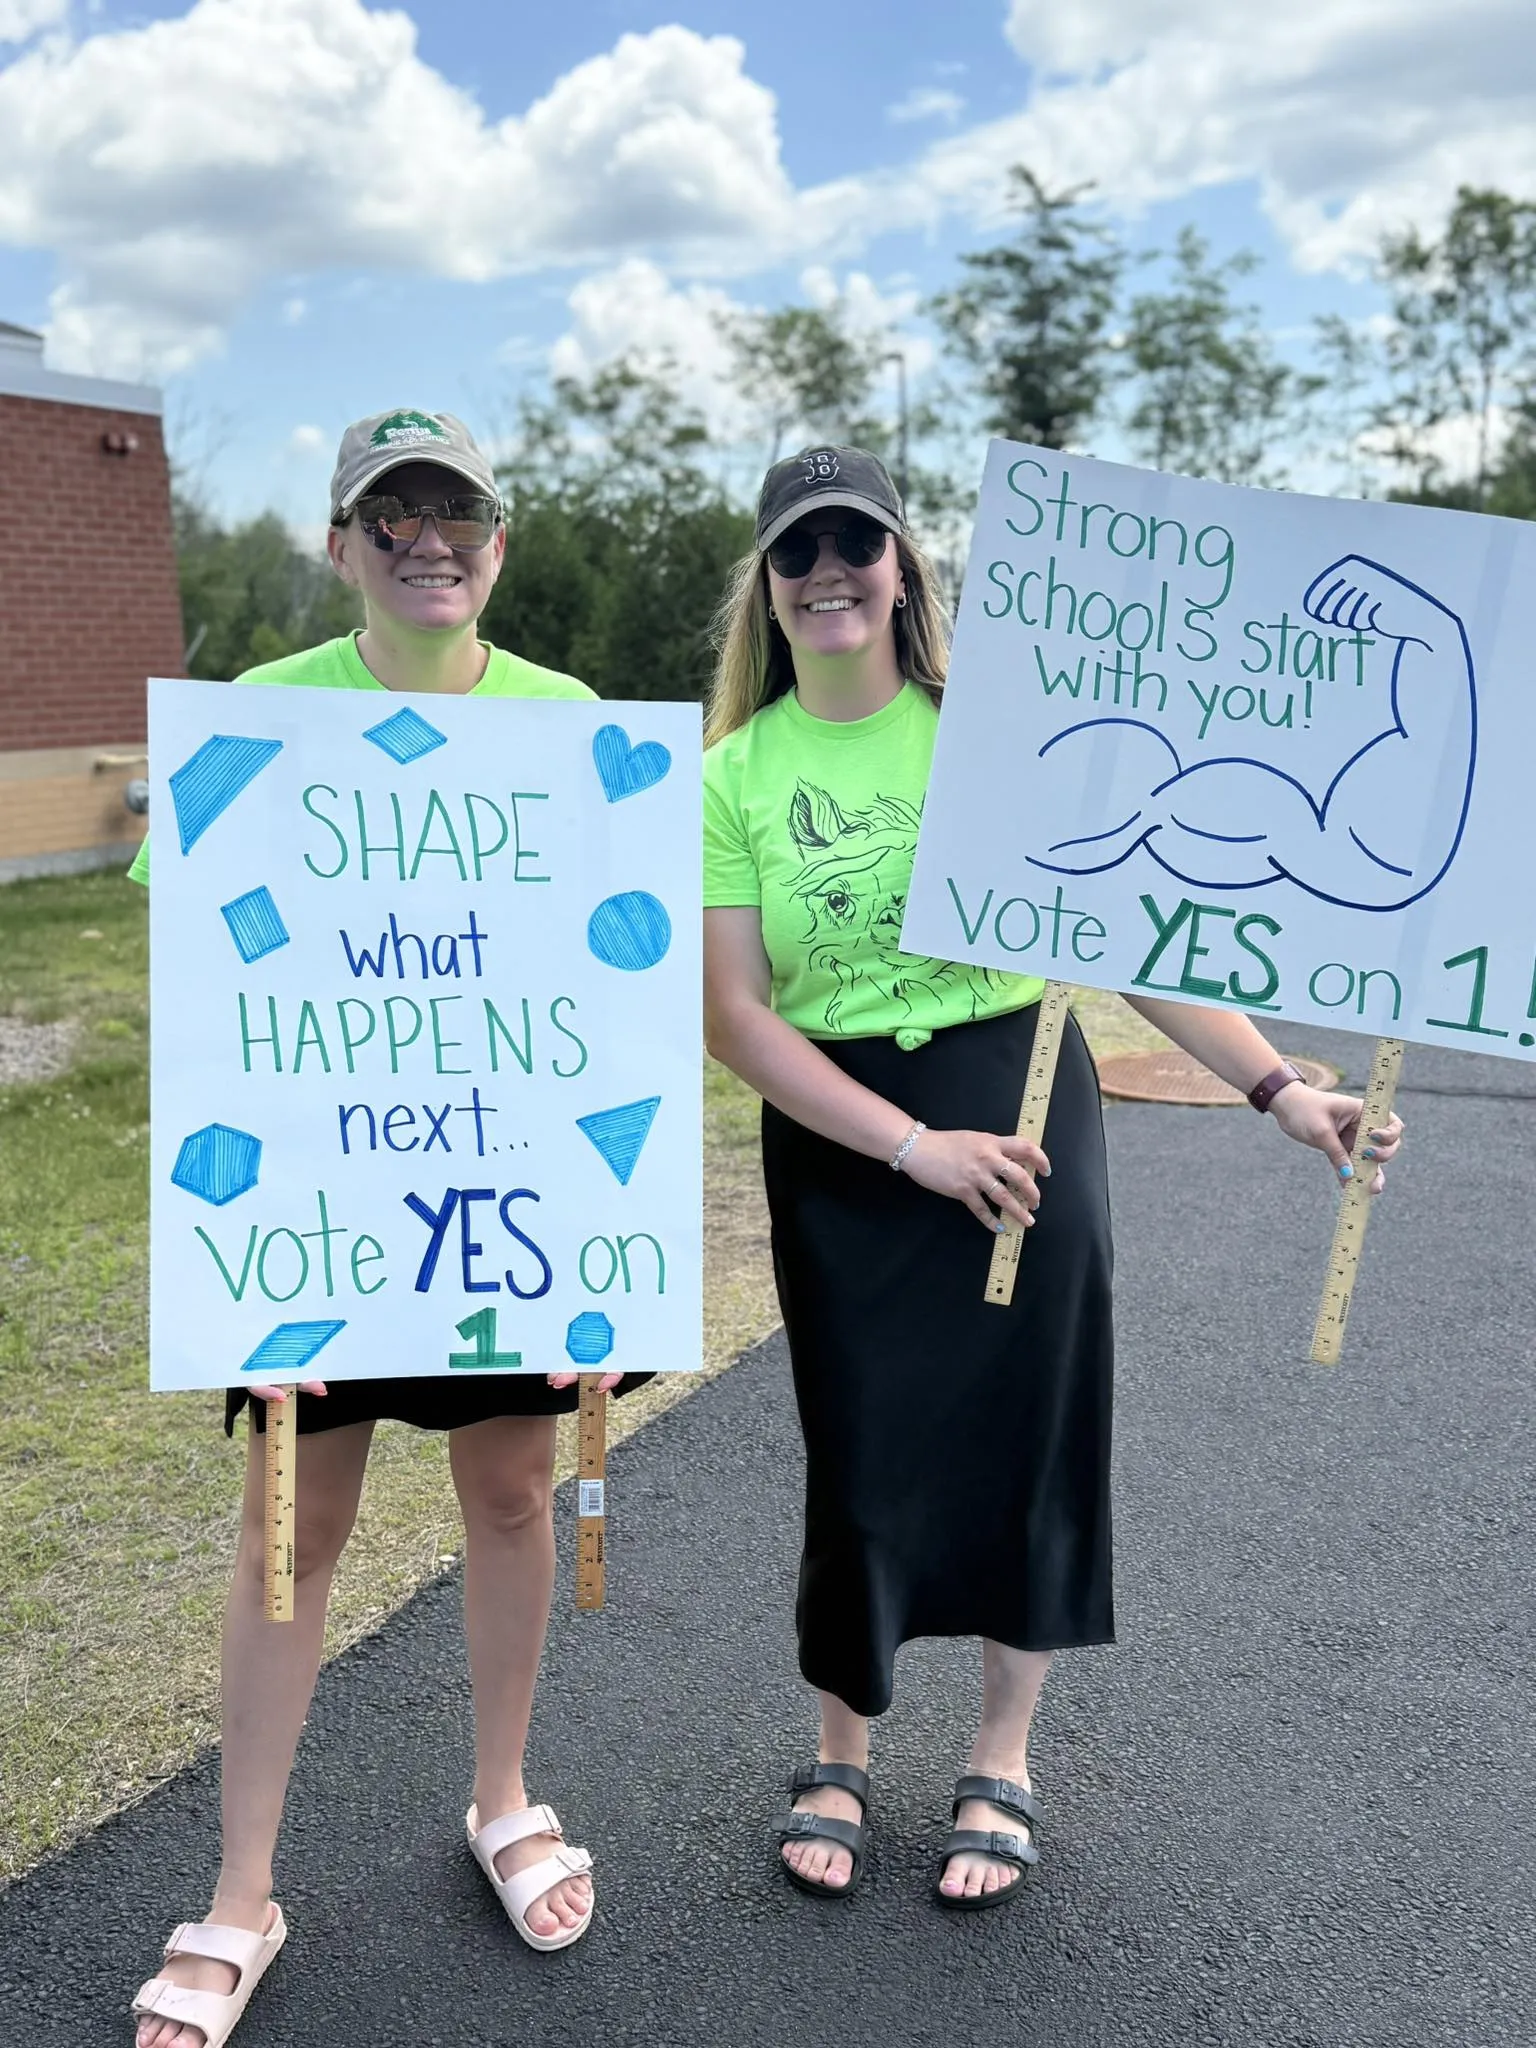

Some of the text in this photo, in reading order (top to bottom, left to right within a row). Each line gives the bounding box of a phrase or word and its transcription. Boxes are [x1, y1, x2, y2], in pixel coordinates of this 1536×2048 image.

[803, 452, 840, 484] B
[1005, 459, 1235, 609] Strong
[1241, 612, 1376, 686] start
[1187, 680, 1314, 740] you!
[303, 784, 551, 881] SHAPE
[339, 910, 488, 979] what
[1131, 894, 1283, 1011] YES
[1309, 963, 1402, 1021] on
[238, 991, 588, 1078] HAPPENS
[338, 1087, 529, 1156] next...
[403, 1187, 553, 1300] YES
[578, 1233, 665, 1295] on
[448, 1306, 522, 1368] 1
